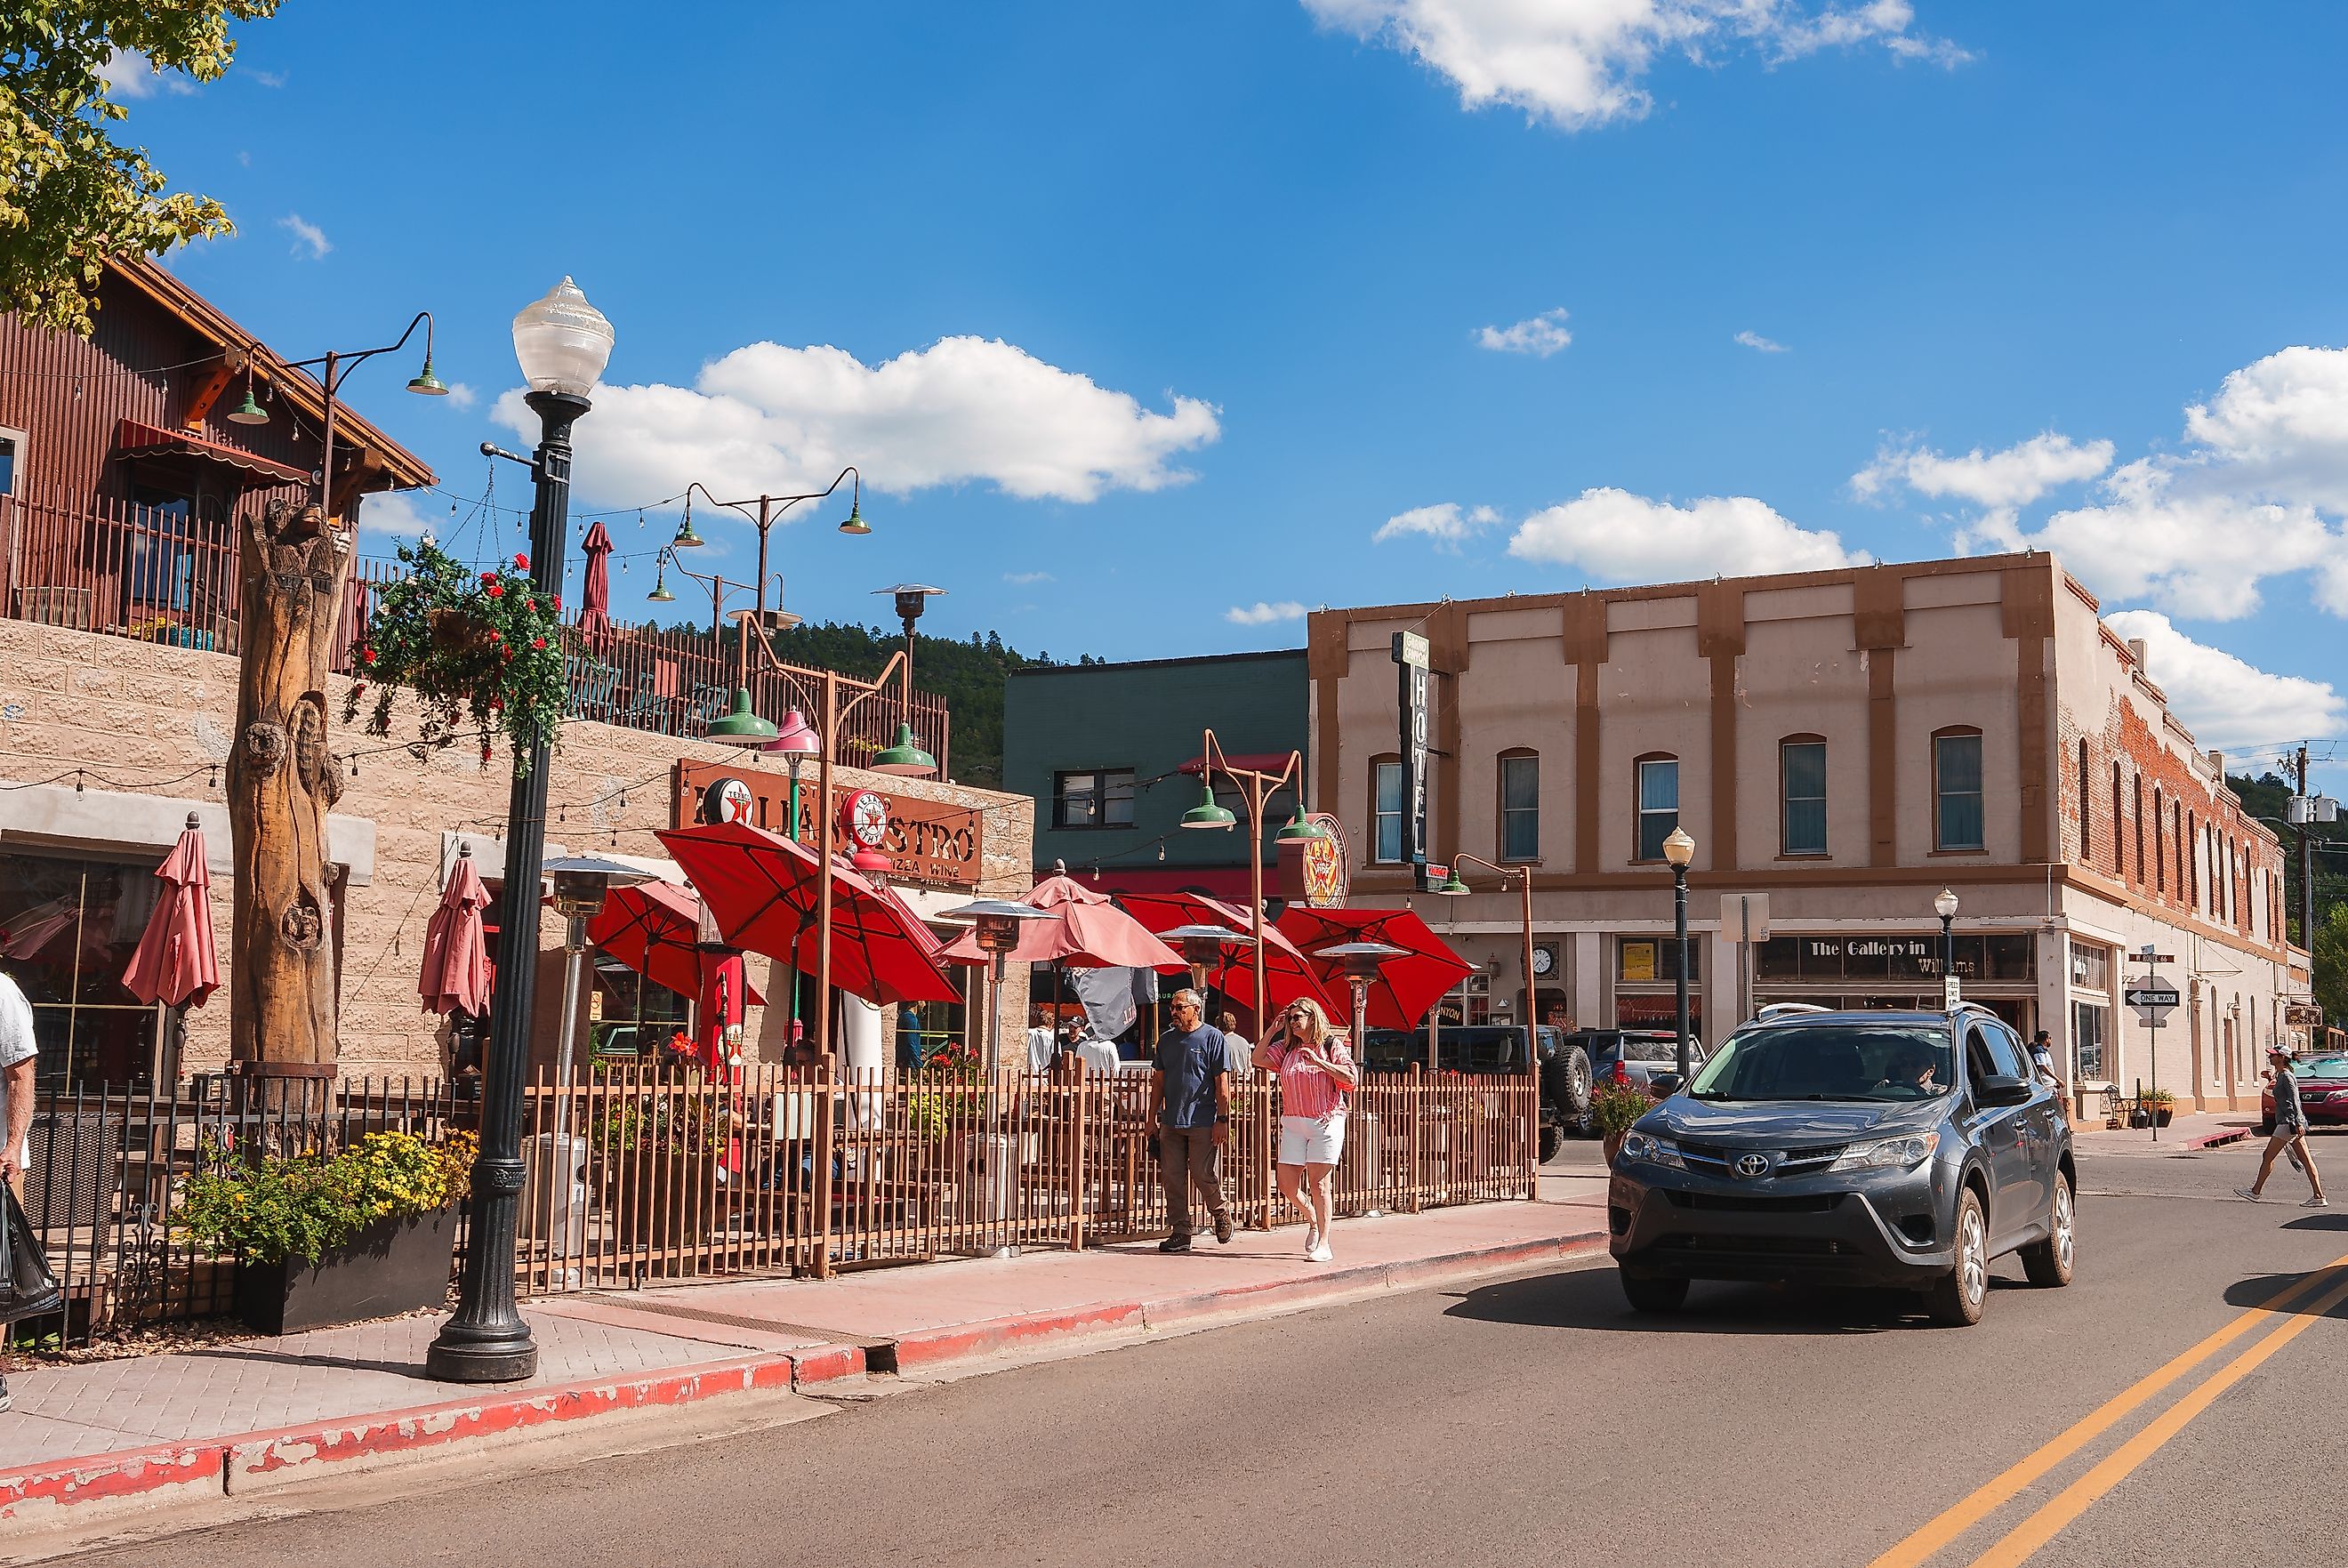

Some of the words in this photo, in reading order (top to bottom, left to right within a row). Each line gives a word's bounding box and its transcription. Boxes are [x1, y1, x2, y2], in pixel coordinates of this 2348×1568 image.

[1406, 636, 1427, 653] GRAND
[1414, 673, 1427, 855] HOTEL
[728, 791, 751, 800] TEXACO
[856, 794, 886, 816] TEXACO
[889, 858, 921, 873] IZZA
[929, 862, 960, 878] WINE
[1810, 941, 1840, 956] The
[1847, 940, 1907, 956] Gallery
[1909, 940, 1926, 955] in
[1918, 958, 1976, 974] Willams
[2142, 954, 2159, 962] ROUTE
[2158, 994, 2174, 1002] WAY
